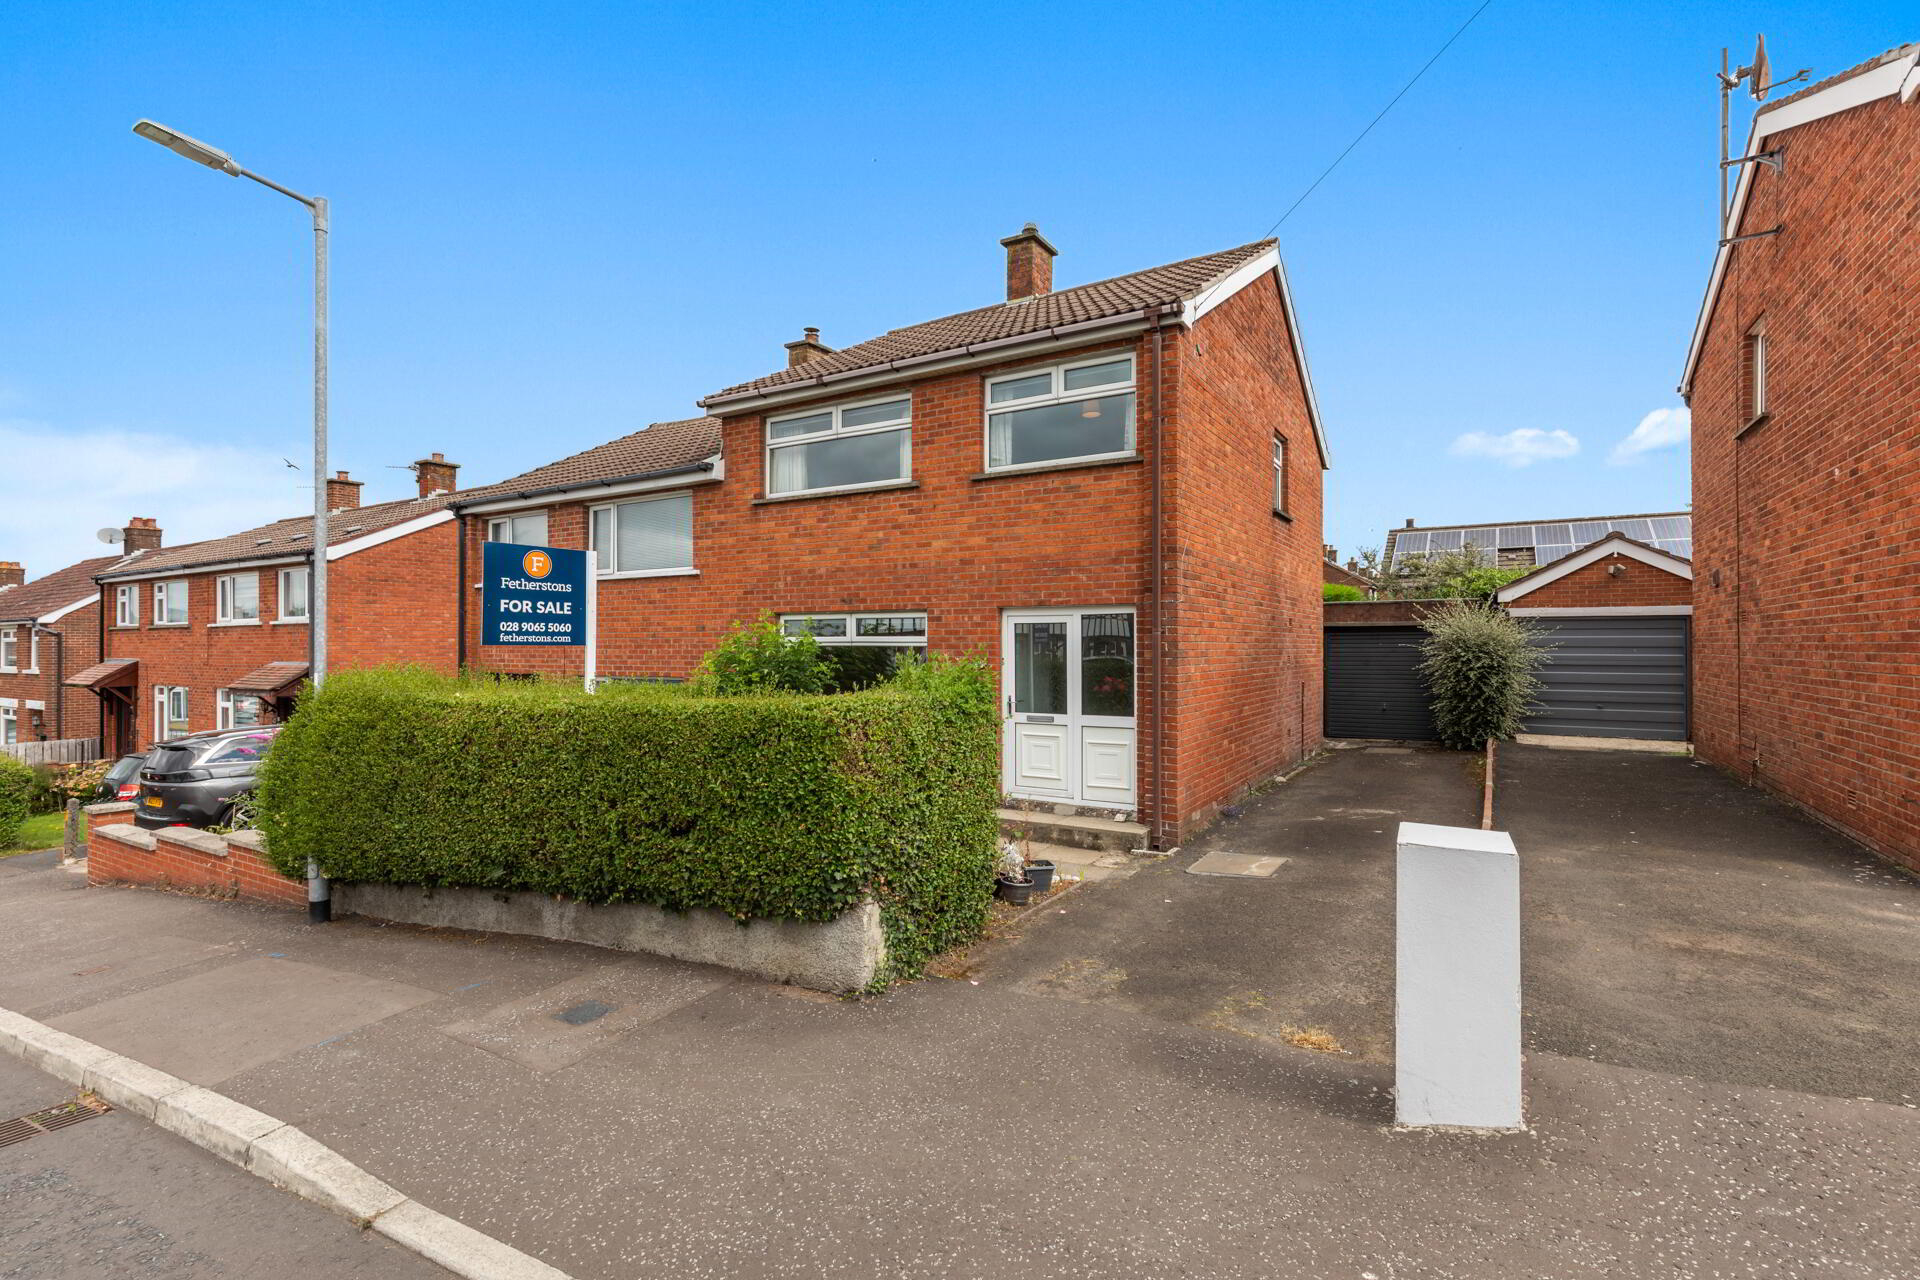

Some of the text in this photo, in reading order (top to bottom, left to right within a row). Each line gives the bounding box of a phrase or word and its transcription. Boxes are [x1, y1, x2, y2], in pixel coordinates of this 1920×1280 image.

[531, 557, 544, 572] F
[501, 577, 572, 592] Fetherstons
[500, 599, 572, 614] FOR SALE
[500, 622, 572, 633] 028 9065 5060
[500, 633, 571, 642] fetherstons.com
